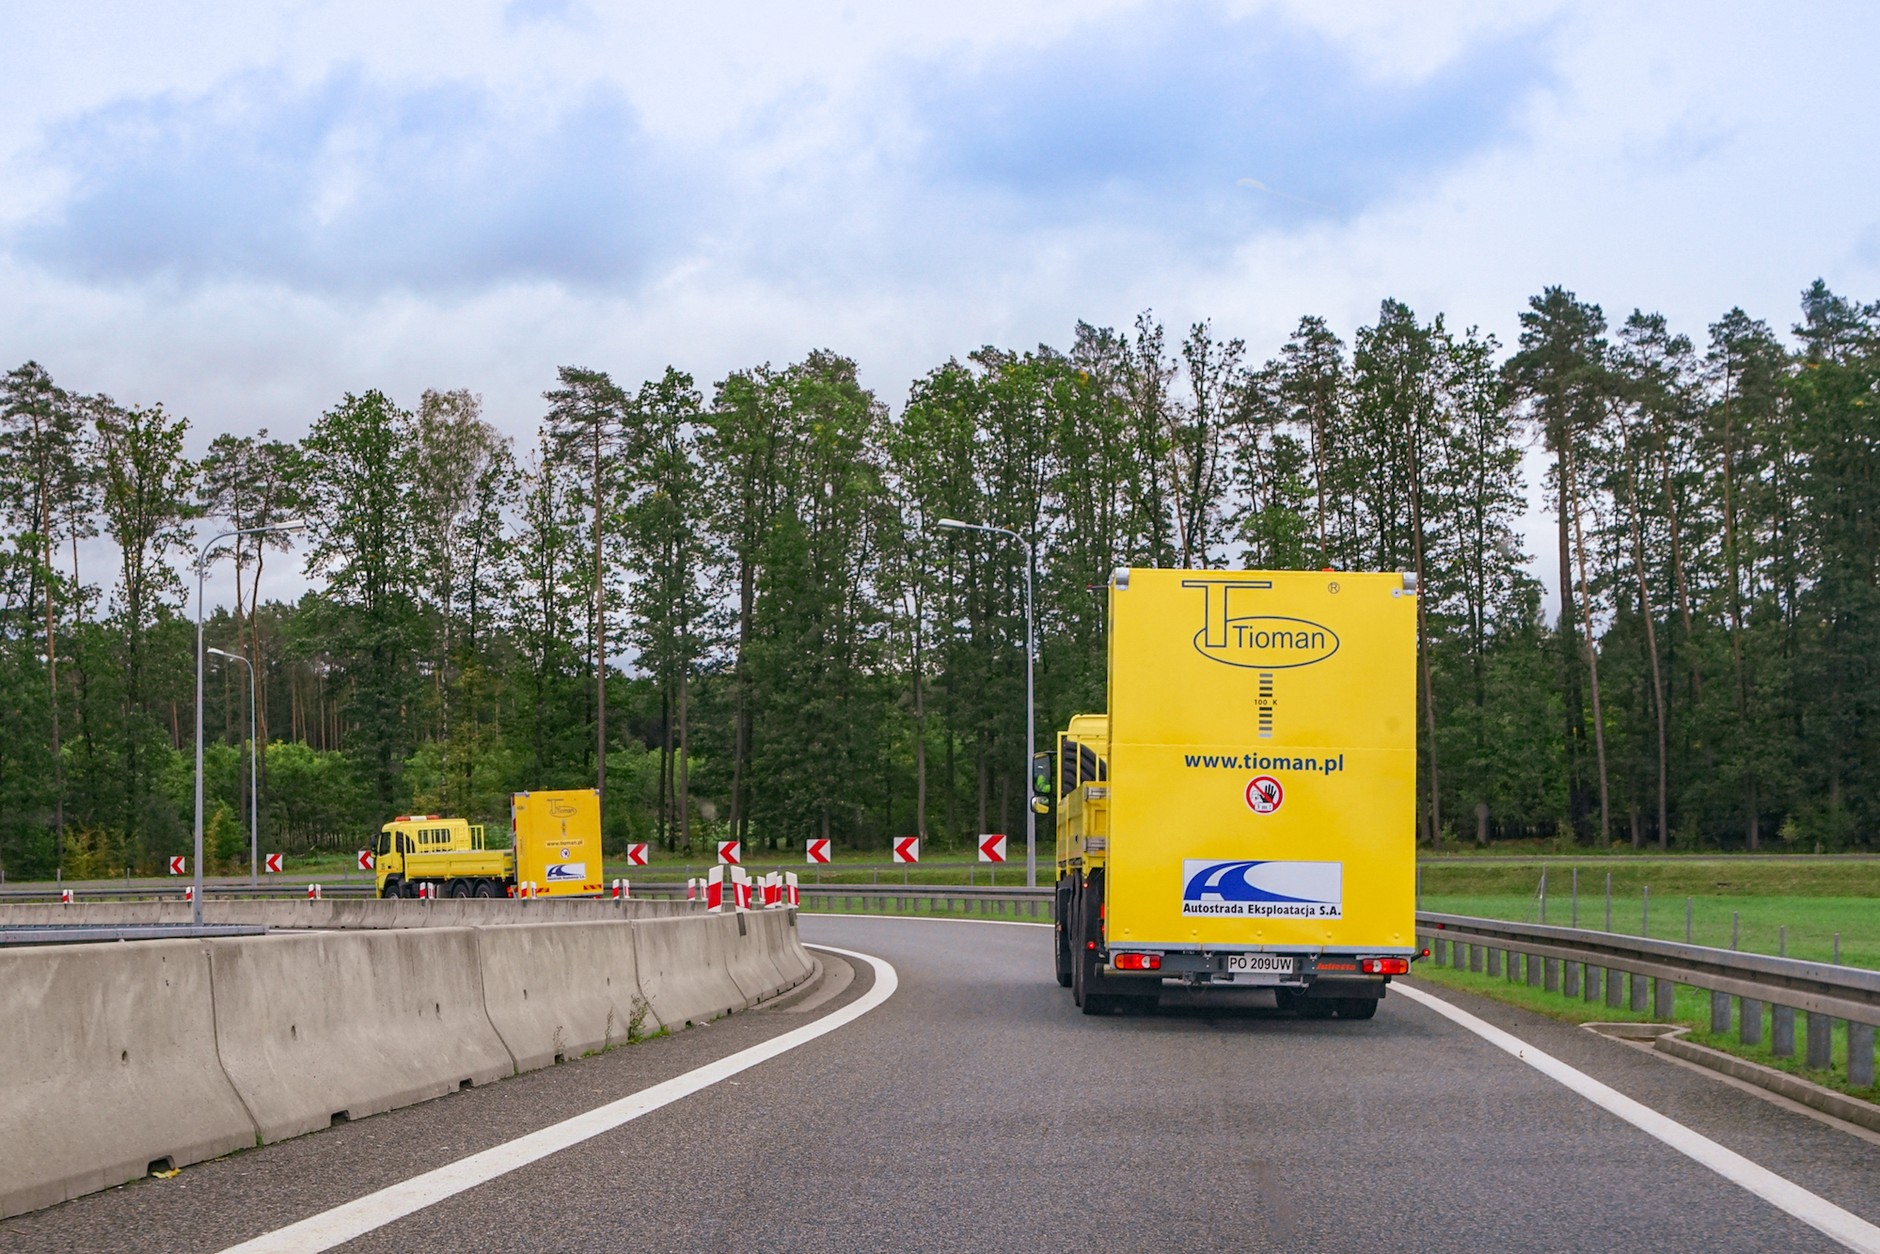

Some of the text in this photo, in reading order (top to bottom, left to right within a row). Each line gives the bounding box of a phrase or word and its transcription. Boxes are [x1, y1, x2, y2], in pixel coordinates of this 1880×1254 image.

[1232, 625, 1325, 649] Tioman
[1184, 752, 1344, 776] www.tioman.pl
[1183, 903, 1342, 917] Autostrada Eksploatacja S.A.
[1230, 957, 1292, 970] PO 209UW
